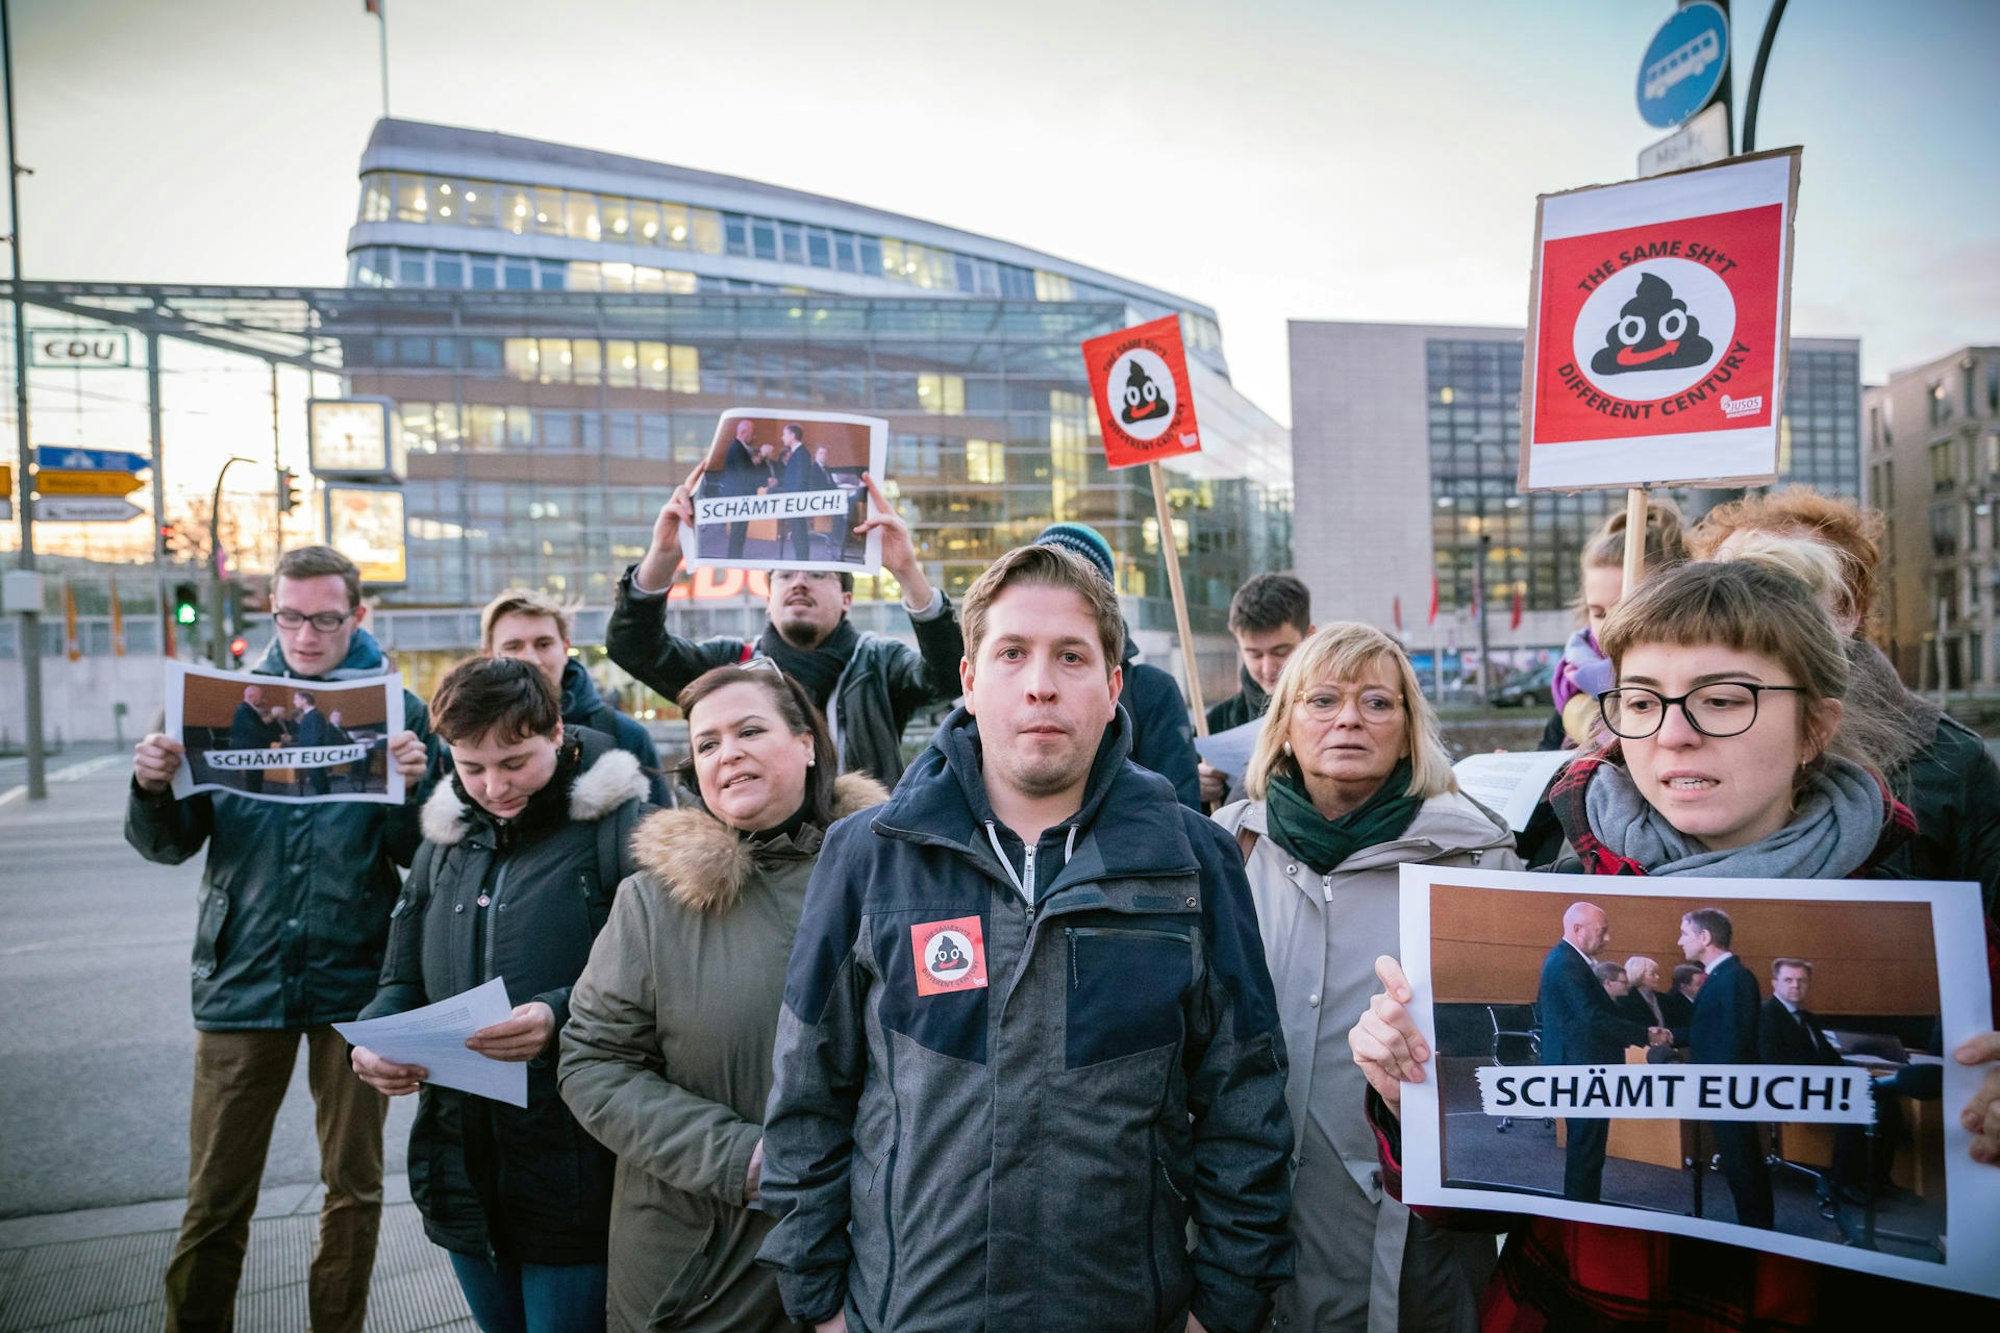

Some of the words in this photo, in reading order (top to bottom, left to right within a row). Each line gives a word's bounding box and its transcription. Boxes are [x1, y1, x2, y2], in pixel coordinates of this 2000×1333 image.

[1577, 259, 1616, 292] THE
[1618, 240, 1681, 267] SAME
[45, 341, 114, 359] CDU
[1557, 362, 1654, 420] DIFFERENT
[1660, 340, 1751, 417] CENTURY
[702, 497, 780, 519] SCHÄMT
[784, 494, 841, 513] EUCH!
[212, 750, 296, 767] SCHÄMT
[301, 748, 360, 764] EUCH!
[1495, 1067, 1686, 1109] SCHÄMT
[1697, 1073, 1852, 1112] EUCH!
